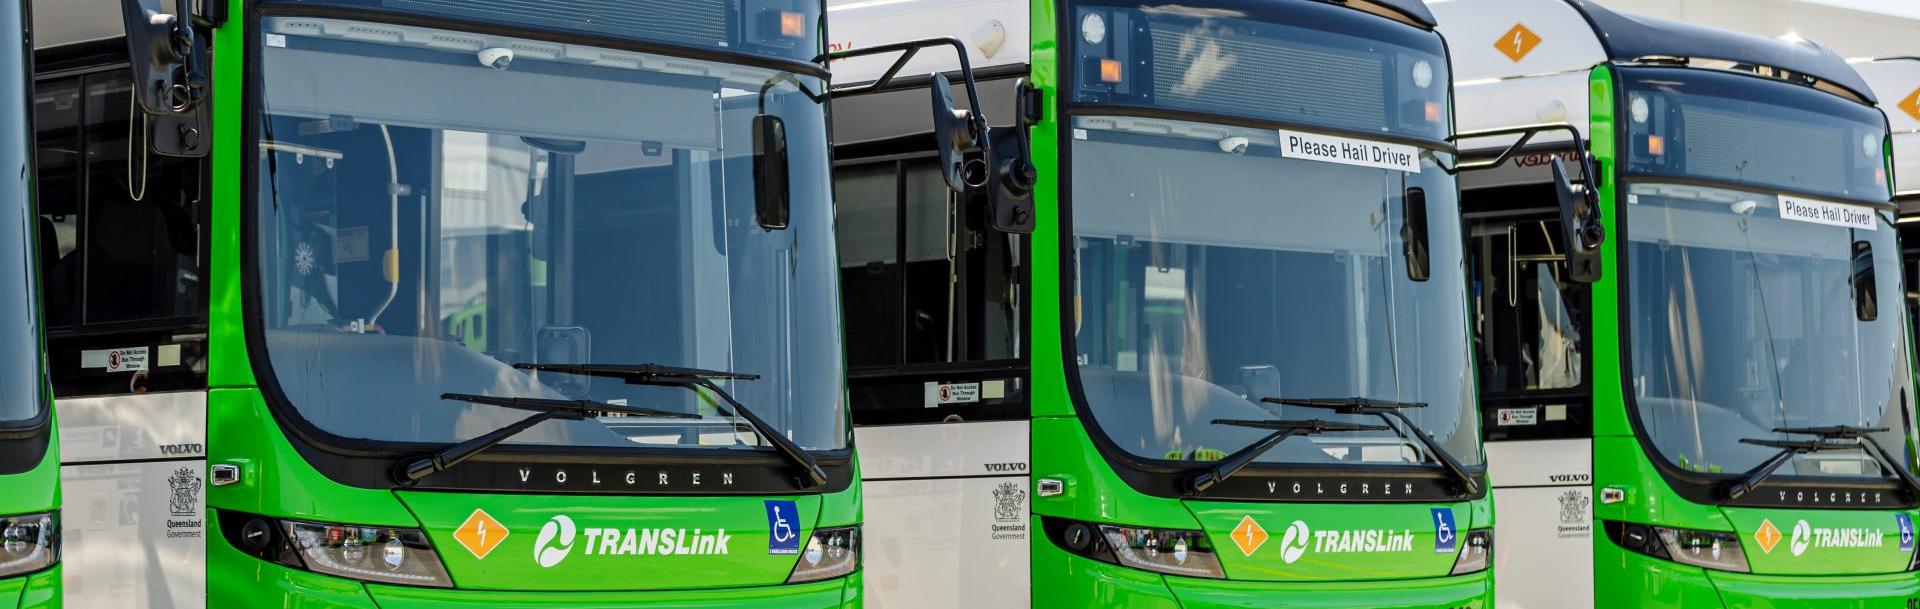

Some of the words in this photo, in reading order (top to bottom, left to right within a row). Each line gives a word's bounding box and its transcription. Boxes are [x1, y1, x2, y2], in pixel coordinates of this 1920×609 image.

[1289, 136, 1337, 158] Please
[1341, 142, 1368, 161] Hail
[1372, 146, 1411, 166] Driver
[1785, 201, 1819, 218] Please
[1822, 205, 1840, 222] Hail
[1843, 209, 1870, 225] Driver
[160, 444, 202, 454] VOLVO
[984, 463, 1026, 472] VOLVO
[519, 469, 733, 485] VOLGREN
[1549, 474, 1589, 482] VOLVO
[1268, 482, 1412, 494] VOLGREN
[1780, 491, 1881, 503] VOLGREN
[167, 520, 201, 528] Queensland
[167, 530, 201, 538] Government
[1814, 528, 1884, 547] TRANSLink
[584, 527, 731, 555] TRANSLink
[1314, 529, 1415, 553] TRANSLink
